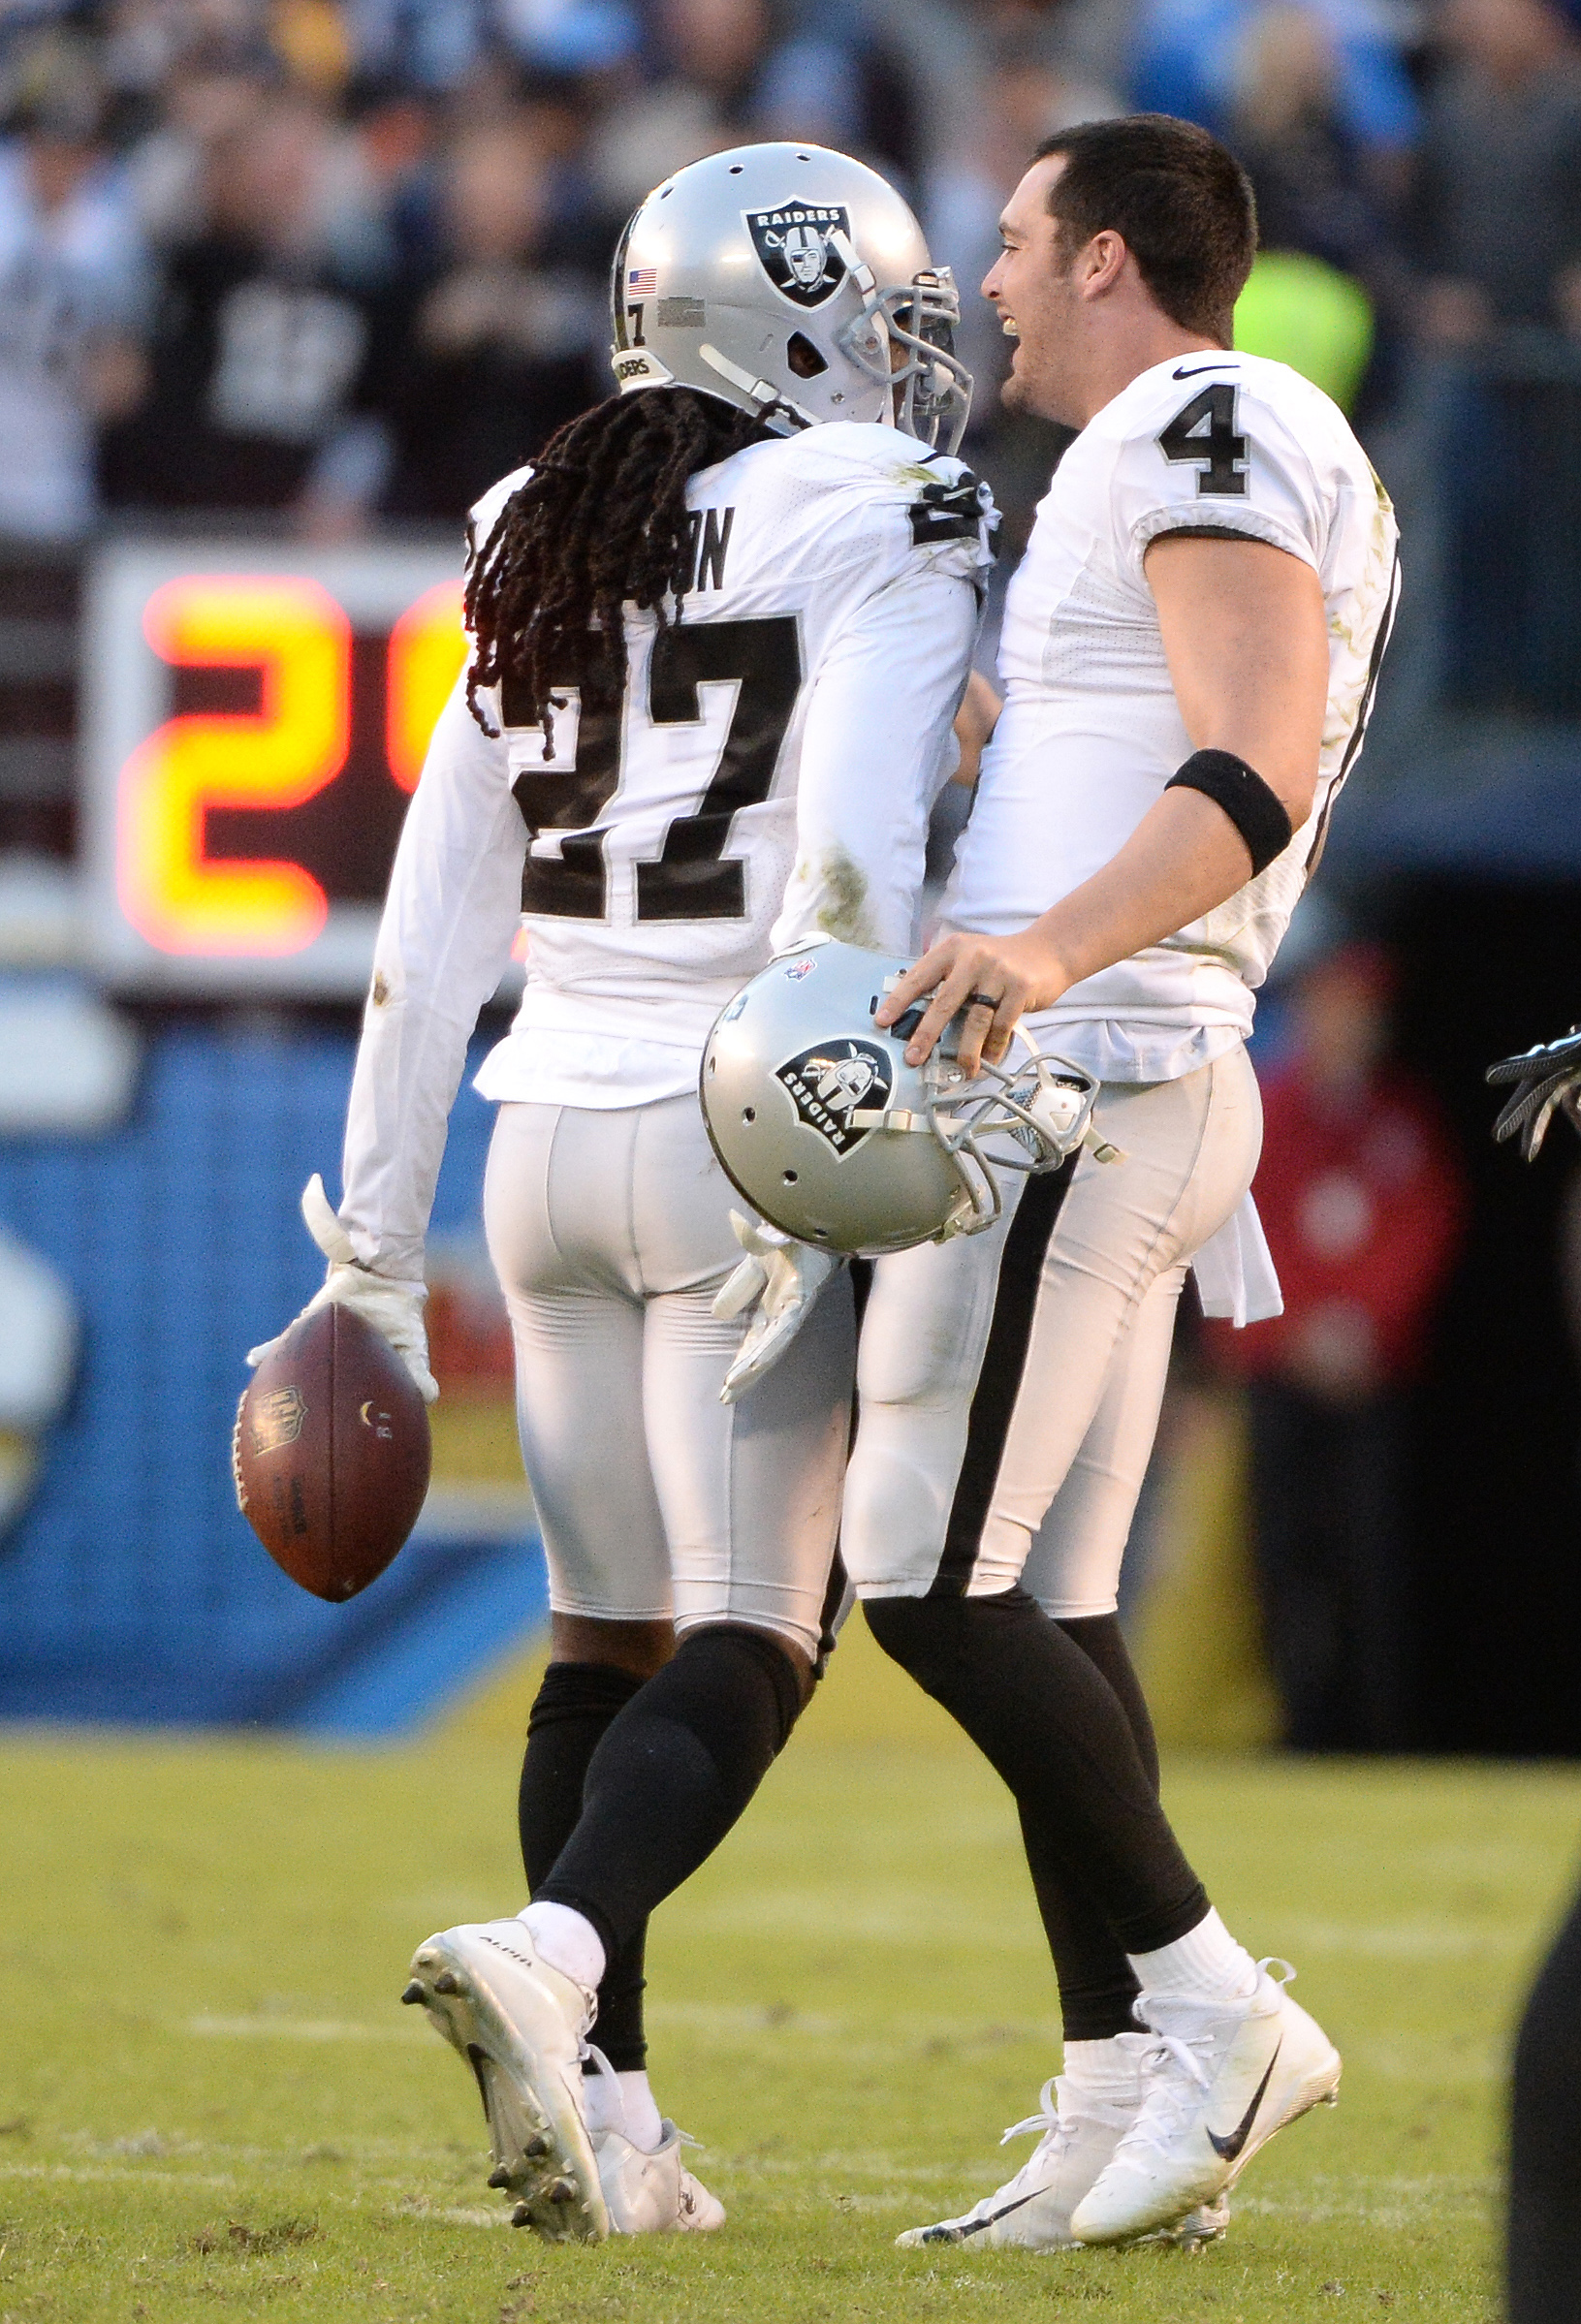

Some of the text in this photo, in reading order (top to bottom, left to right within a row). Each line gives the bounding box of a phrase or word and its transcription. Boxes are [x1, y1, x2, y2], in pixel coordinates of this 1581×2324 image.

[756, 208, 840, 227] RAIDERS
[627, 302, 647, 347] 7
[1155, 383, 1249, 498] 4
[496, 611, 806, 926] 27
[783, 1072, 846, 1146] RAIDERS
